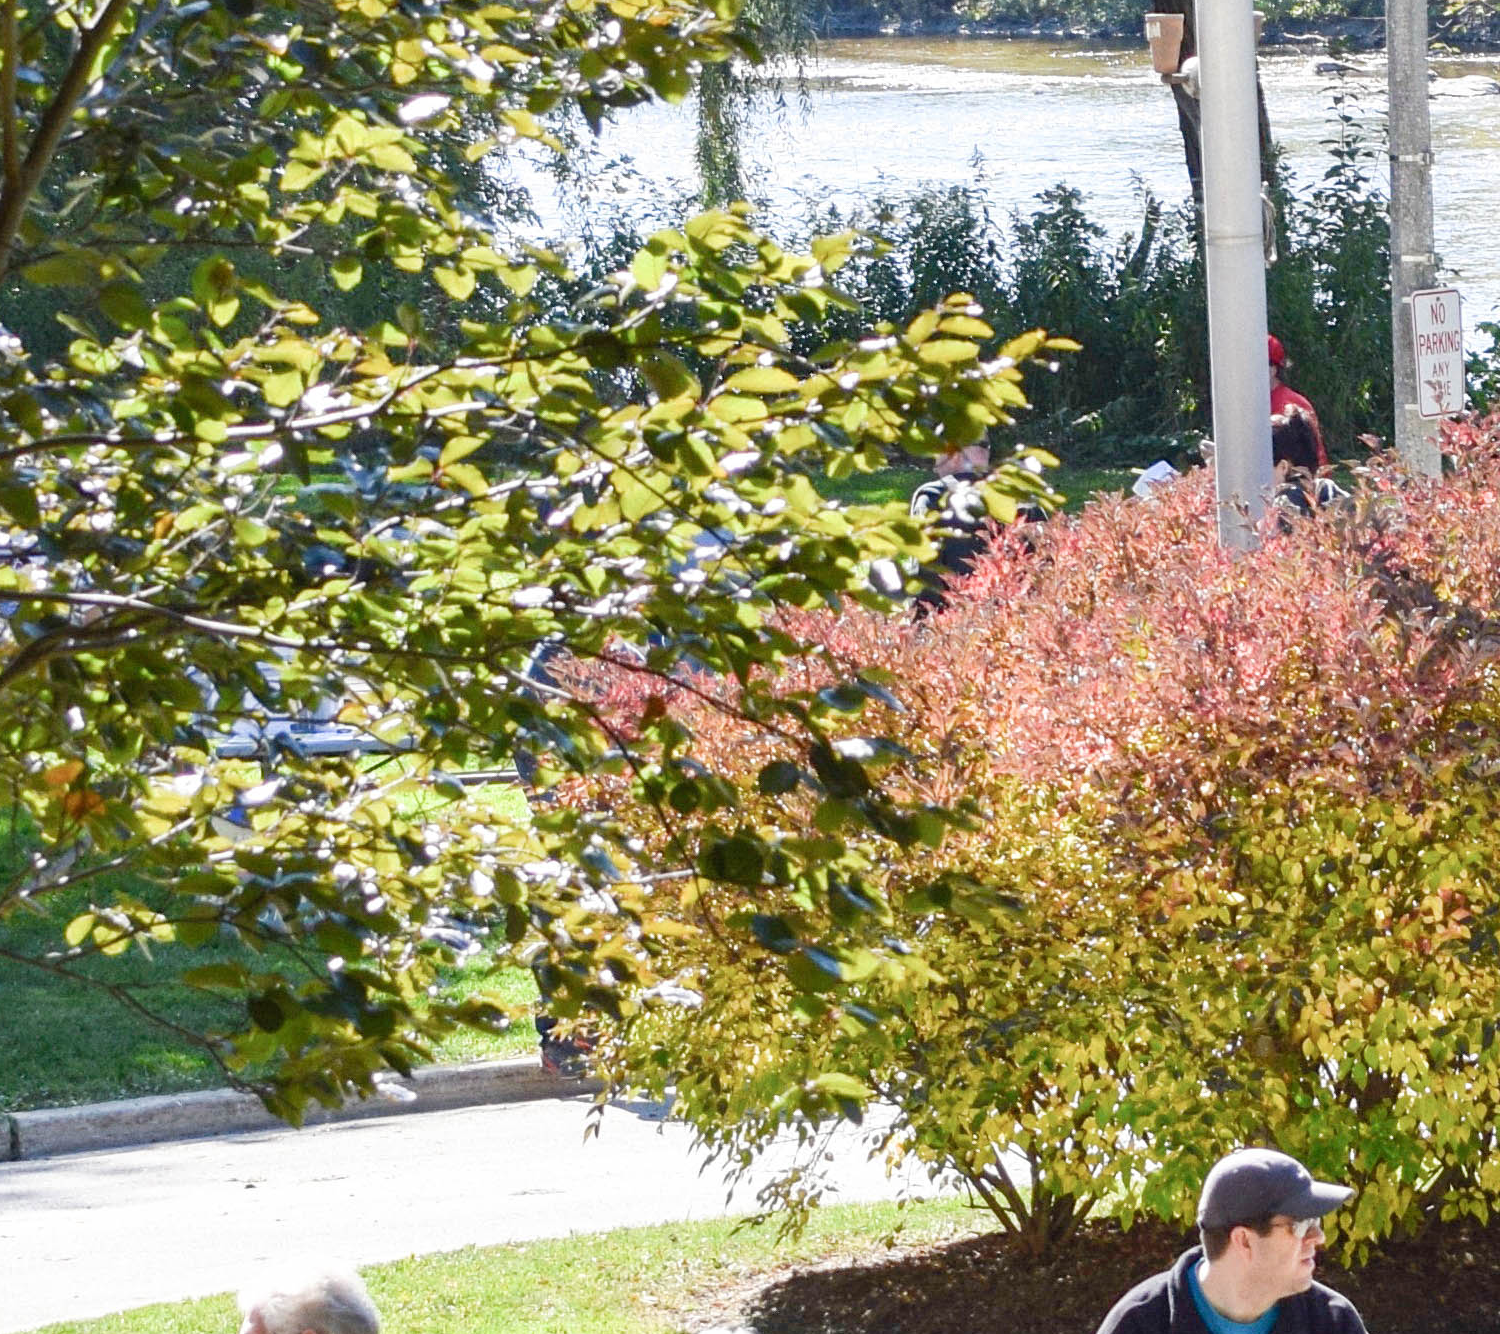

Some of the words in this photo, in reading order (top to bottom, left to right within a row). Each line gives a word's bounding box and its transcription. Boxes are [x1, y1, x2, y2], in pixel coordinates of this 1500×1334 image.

[1430, 302, 1446, 326] NO
[1418, 330, 1461, 356] PARKING
[1432, 361, 1451, 378] ANY
